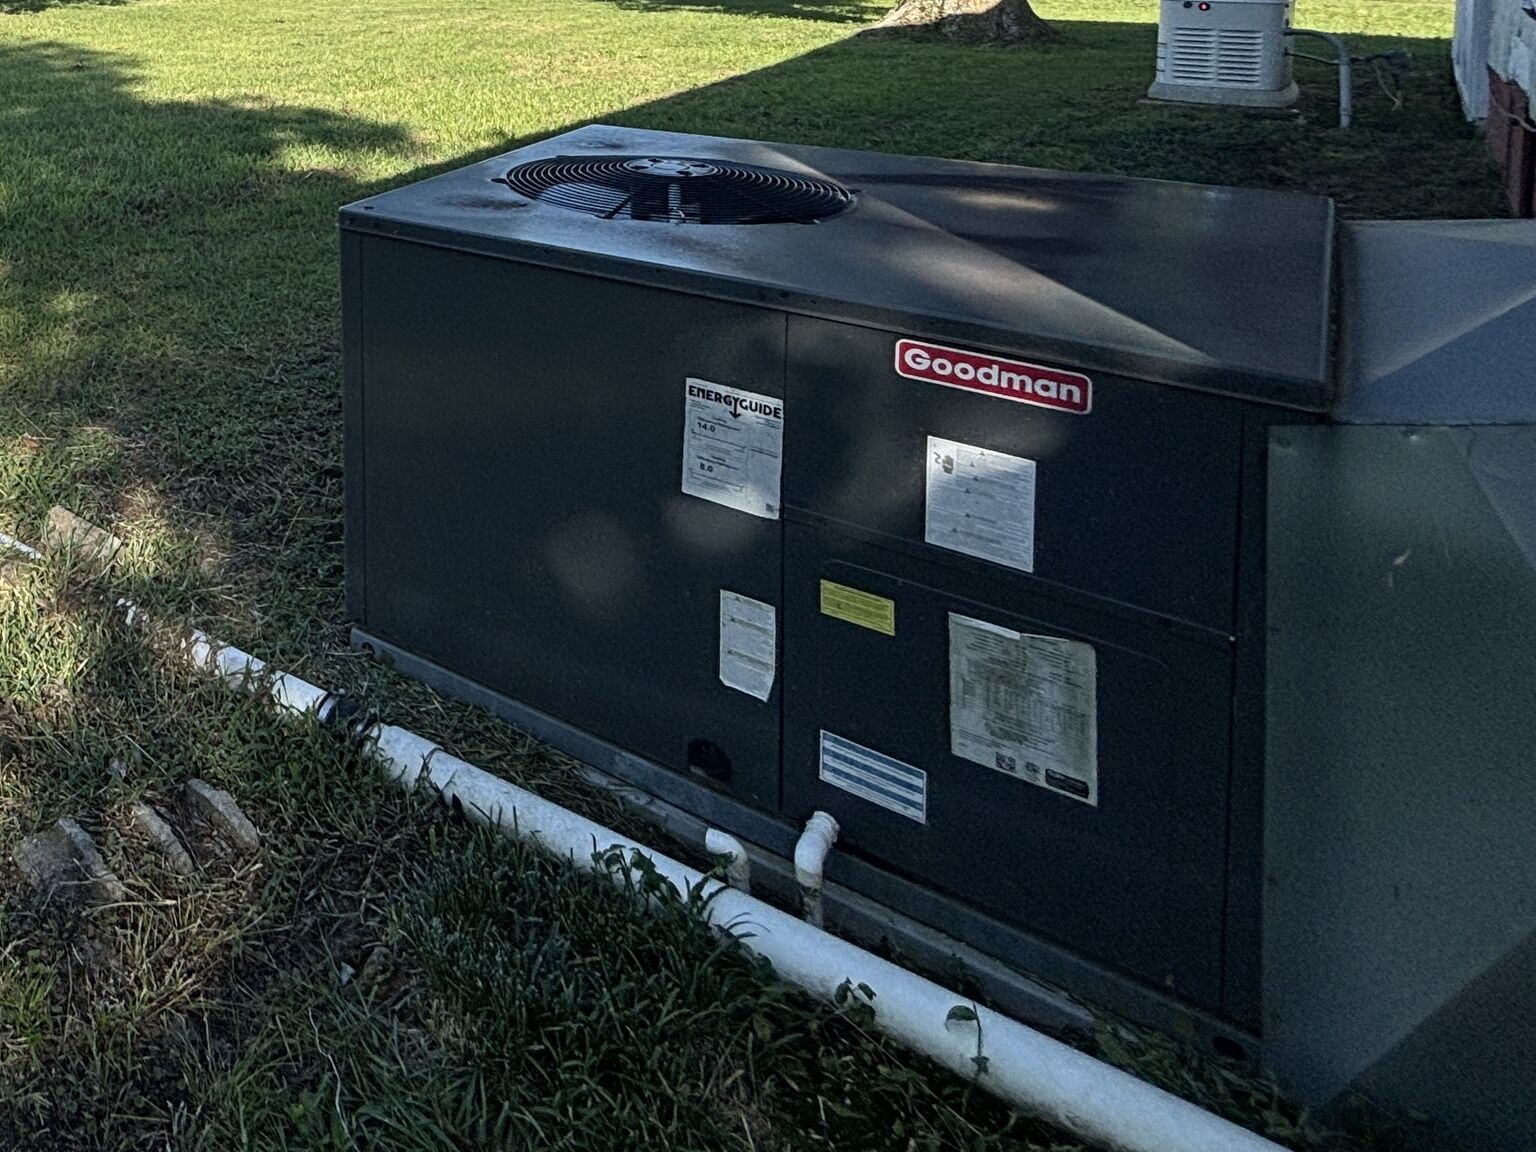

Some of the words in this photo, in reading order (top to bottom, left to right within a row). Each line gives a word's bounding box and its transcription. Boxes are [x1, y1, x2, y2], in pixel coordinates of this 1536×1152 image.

[904, 348, 1081, 404] Goodman
[688, 385, 782, 419] ENERGYGUIDE
[697, 422, 716, 433] 14.0
